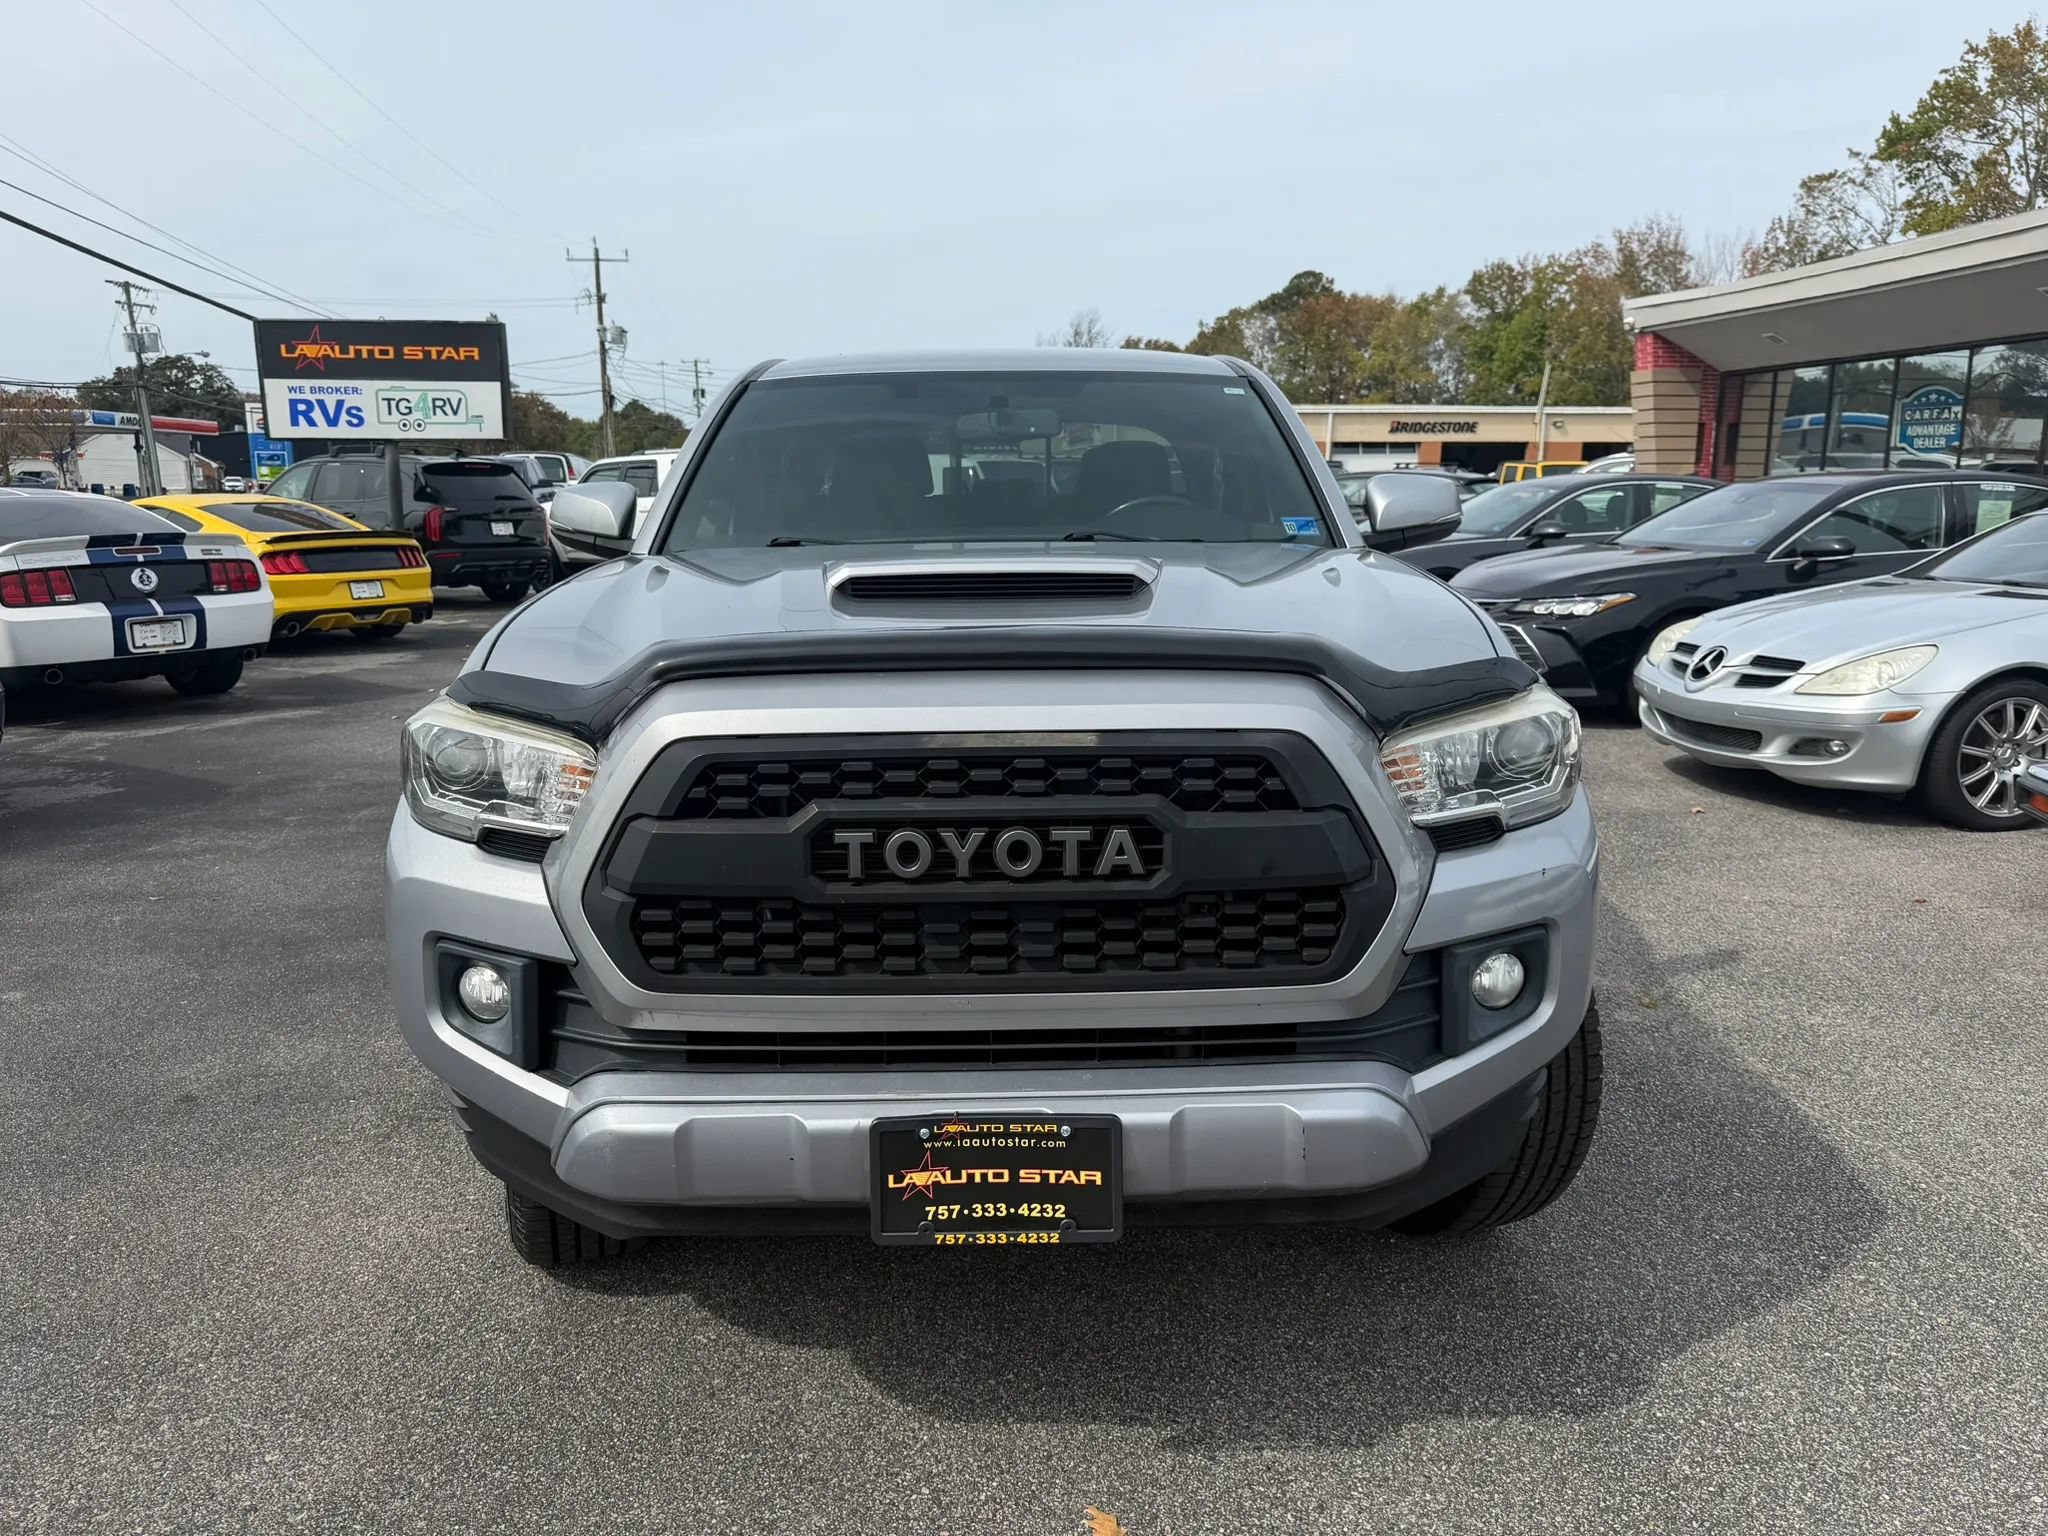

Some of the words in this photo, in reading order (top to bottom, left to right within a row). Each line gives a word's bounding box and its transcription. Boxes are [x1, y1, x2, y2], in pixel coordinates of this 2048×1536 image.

[314, 344, 395, 360] AUTO
[403, 346, 480, 361] STAR
[287, 385, 305, 395] WE
[309, 386, 363, 396] BROKER:
[381, 391, 463, 420] TG4RV
[288, 398, 366, 429] RVs
[1904, 406, 1962, 421] CARFAX
[1388, 420, 1479, 434] BRIDGESTONE
[1906, 424, 1957, 436] ADVANTAGE
[1913, 437, 1946, 449] DEALER
[832, 825, 1147, 879] TOYOTA
[955, 1124, 1003, 1133] AUTO
[1009, 1123, 1057, 1133] STAR
[927, 1169, 1010, 1185] AUTO
[1018, 1169, 1102, 1186] STAR
